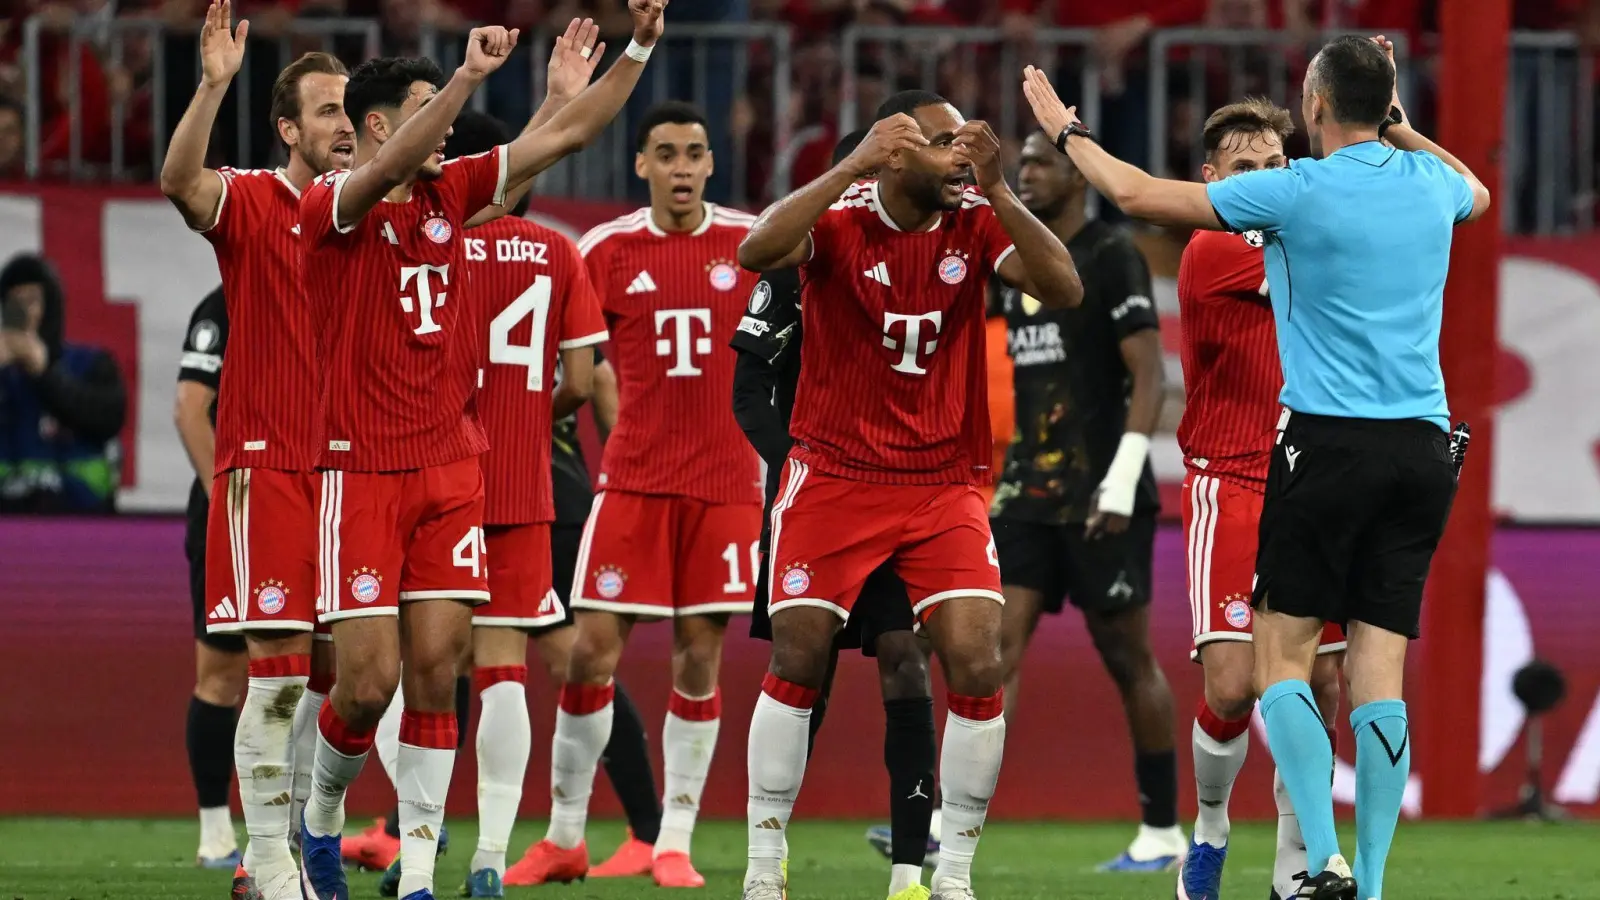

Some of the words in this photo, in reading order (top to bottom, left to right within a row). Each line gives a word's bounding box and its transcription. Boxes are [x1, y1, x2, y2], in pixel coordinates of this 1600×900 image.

[496, 236, 548, 265] DÍAZ
[400, 263, 449, 335] T
[478, 274, 552, 392] 4
[654, 308, 711, 377] T
[882, 311, 942, 375] T
